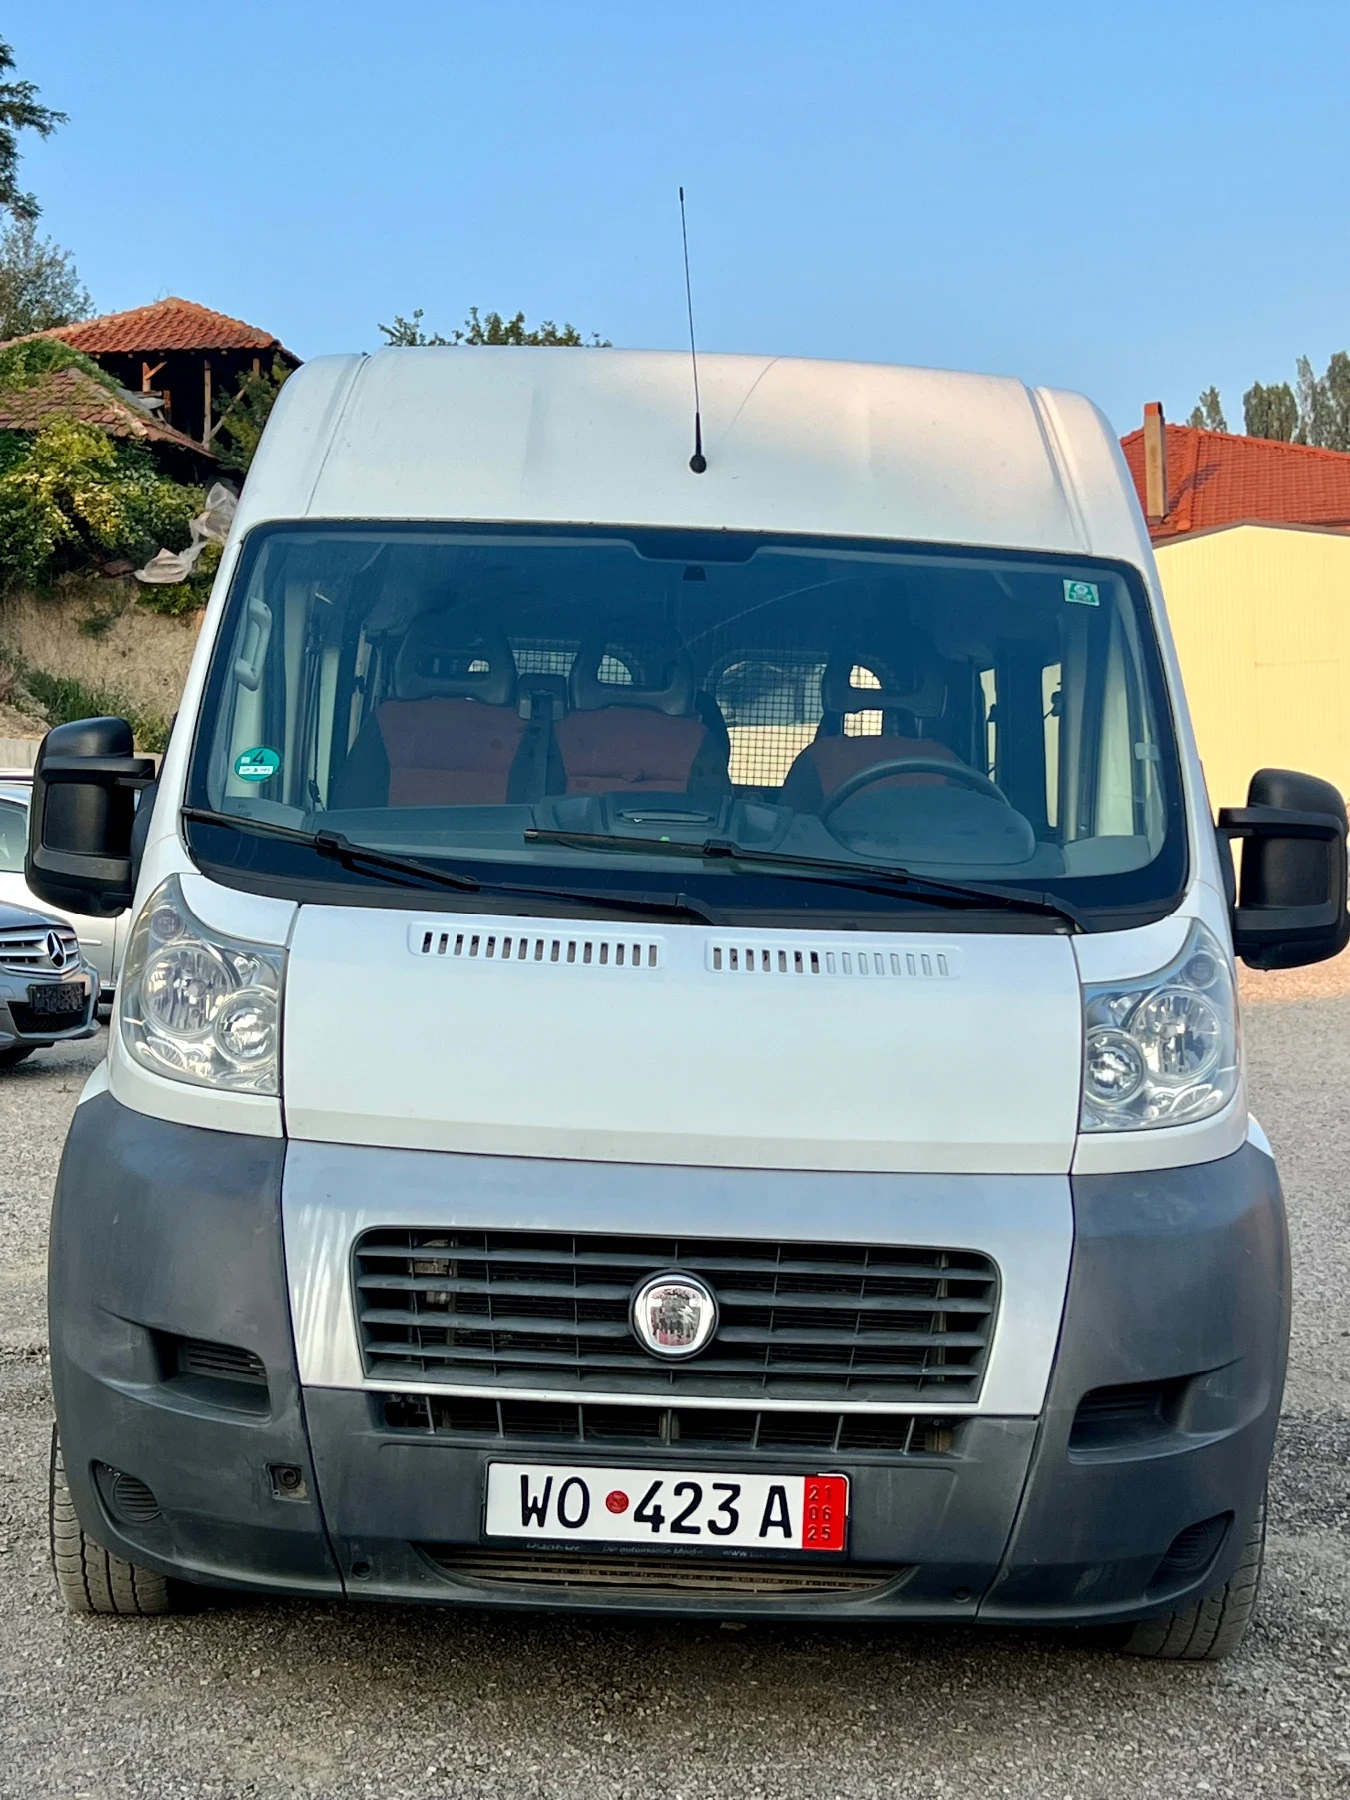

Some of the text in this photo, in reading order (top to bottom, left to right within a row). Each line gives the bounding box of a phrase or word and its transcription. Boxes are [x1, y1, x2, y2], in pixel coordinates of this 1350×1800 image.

[251, 749, 265, 765] 4
[807, 1483, 832, 1502] 21
[520, 1474, 793, 1539] WO 423 A
[807, 1504, 833, 1521] 06
[806, 1524, 832, 1542] 25
